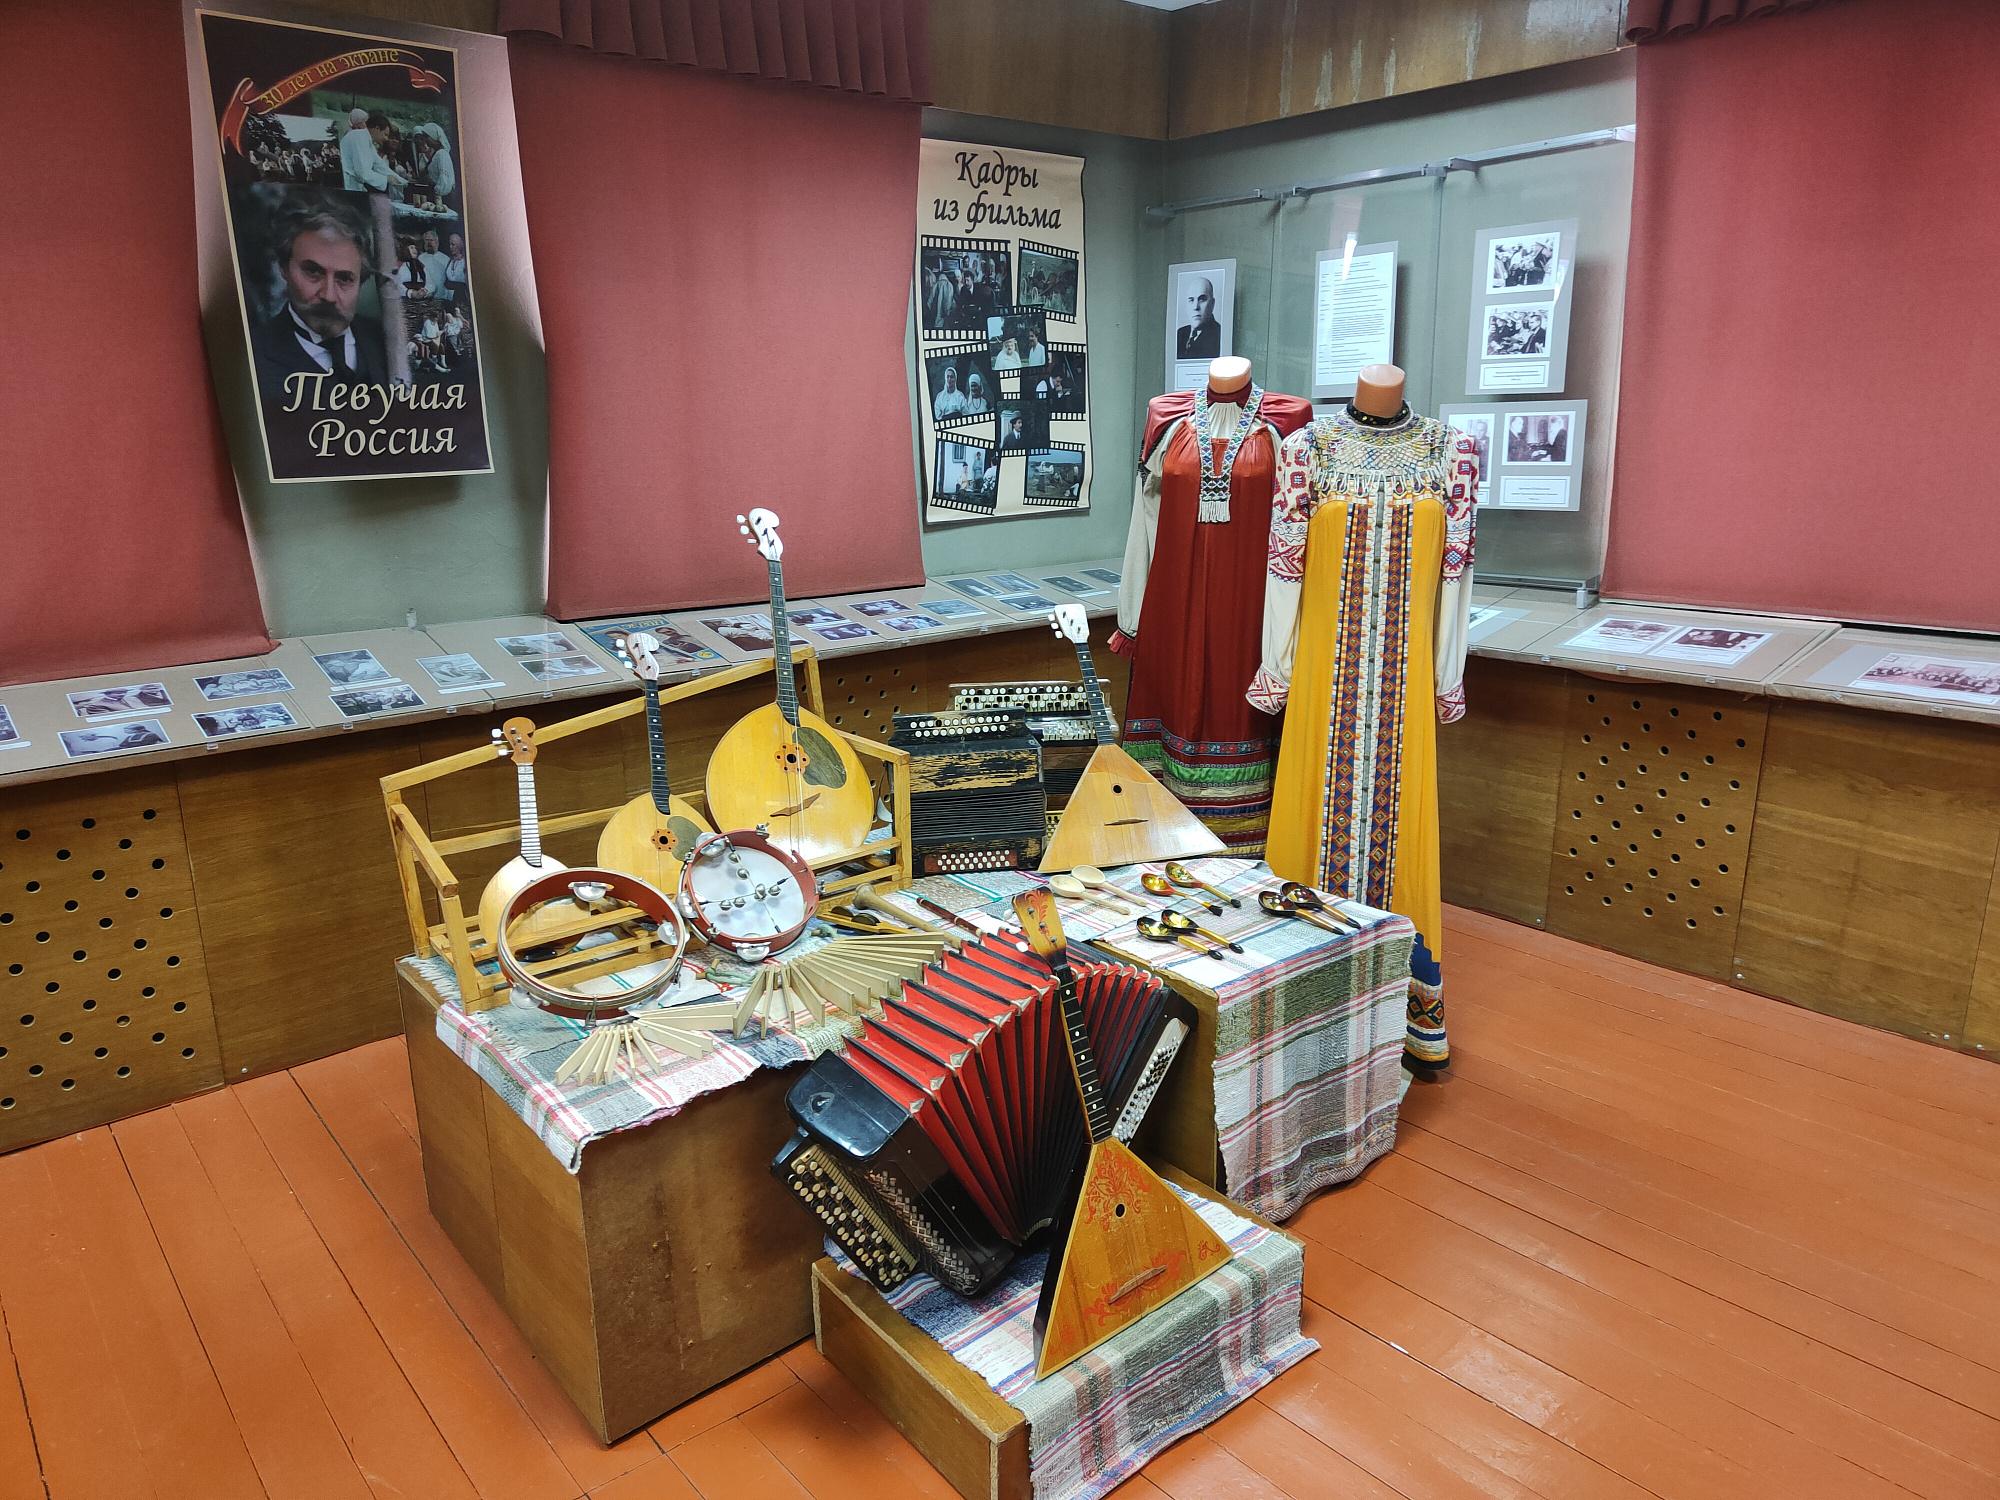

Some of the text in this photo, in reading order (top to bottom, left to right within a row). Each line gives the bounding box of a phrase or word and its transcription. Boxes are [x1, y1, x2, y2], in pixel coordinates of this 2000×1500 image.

[260, 49, 399, 109] 30 лет на экране
[955, 150, 1039, 196] Кадры
[933, 190, 1062, 234] из фильма
[282, 367, 468, 425] Певучая
[308, 418, 458, 457] Россия
